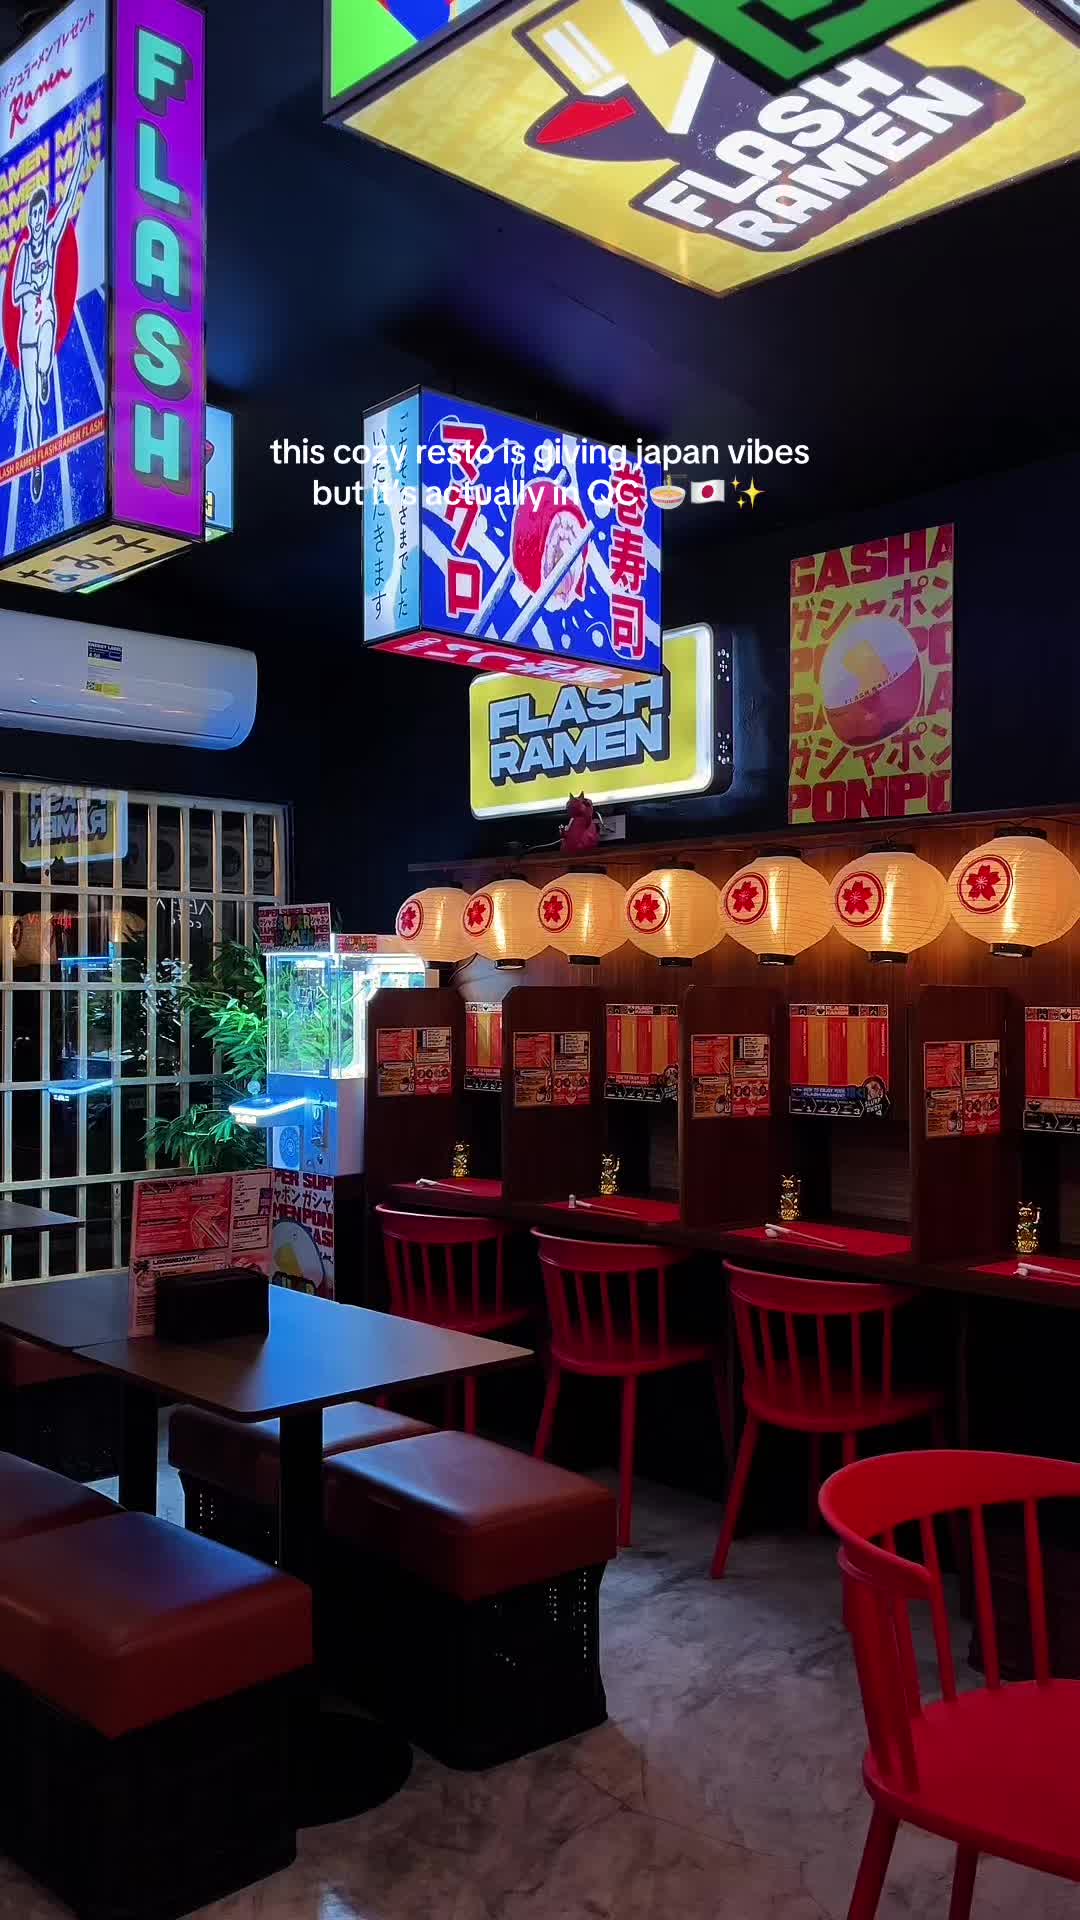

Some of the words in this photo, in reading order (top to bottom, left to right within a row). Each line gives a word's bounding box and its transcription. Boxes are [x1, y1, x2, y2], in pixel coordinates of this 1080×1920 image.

[9, 67, 72, 139] Ramen
[644, 58, 903, 228] FLASH
[715, 76, 984, 247] RAMEN
[134, 26, 193, 496] FLASH
[490, 677, 665, 741] FLASH
[491, 713, 664, 780] RAMEN
